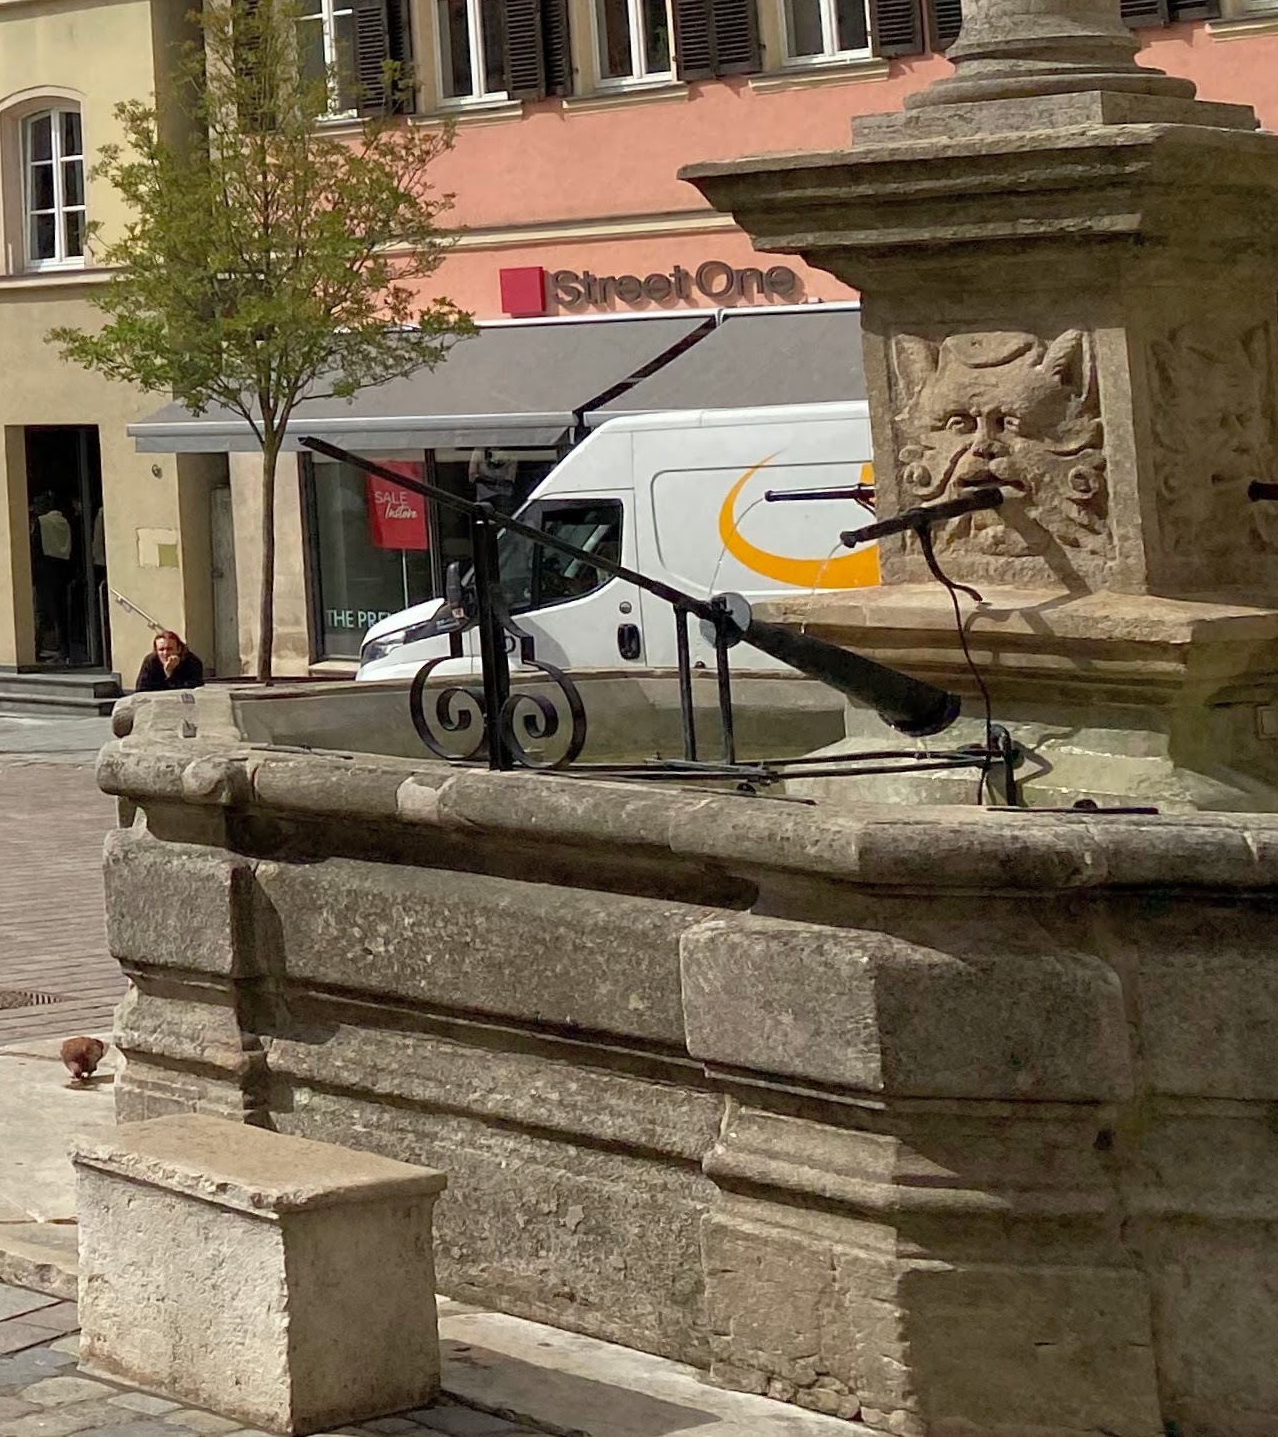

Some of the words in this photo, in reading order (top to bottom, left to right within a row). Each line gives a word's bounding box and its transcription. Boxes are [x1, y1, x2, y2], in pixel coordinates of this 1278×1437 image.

[552, 265, 689, 305] Street
[696, 261, 794, 296] One
[374, 491, 408, 505] SALE
[384, 502, 418, 519] Instore
[326, 609, 354, 628] THE
[358, 610, 392, 628] PRE
